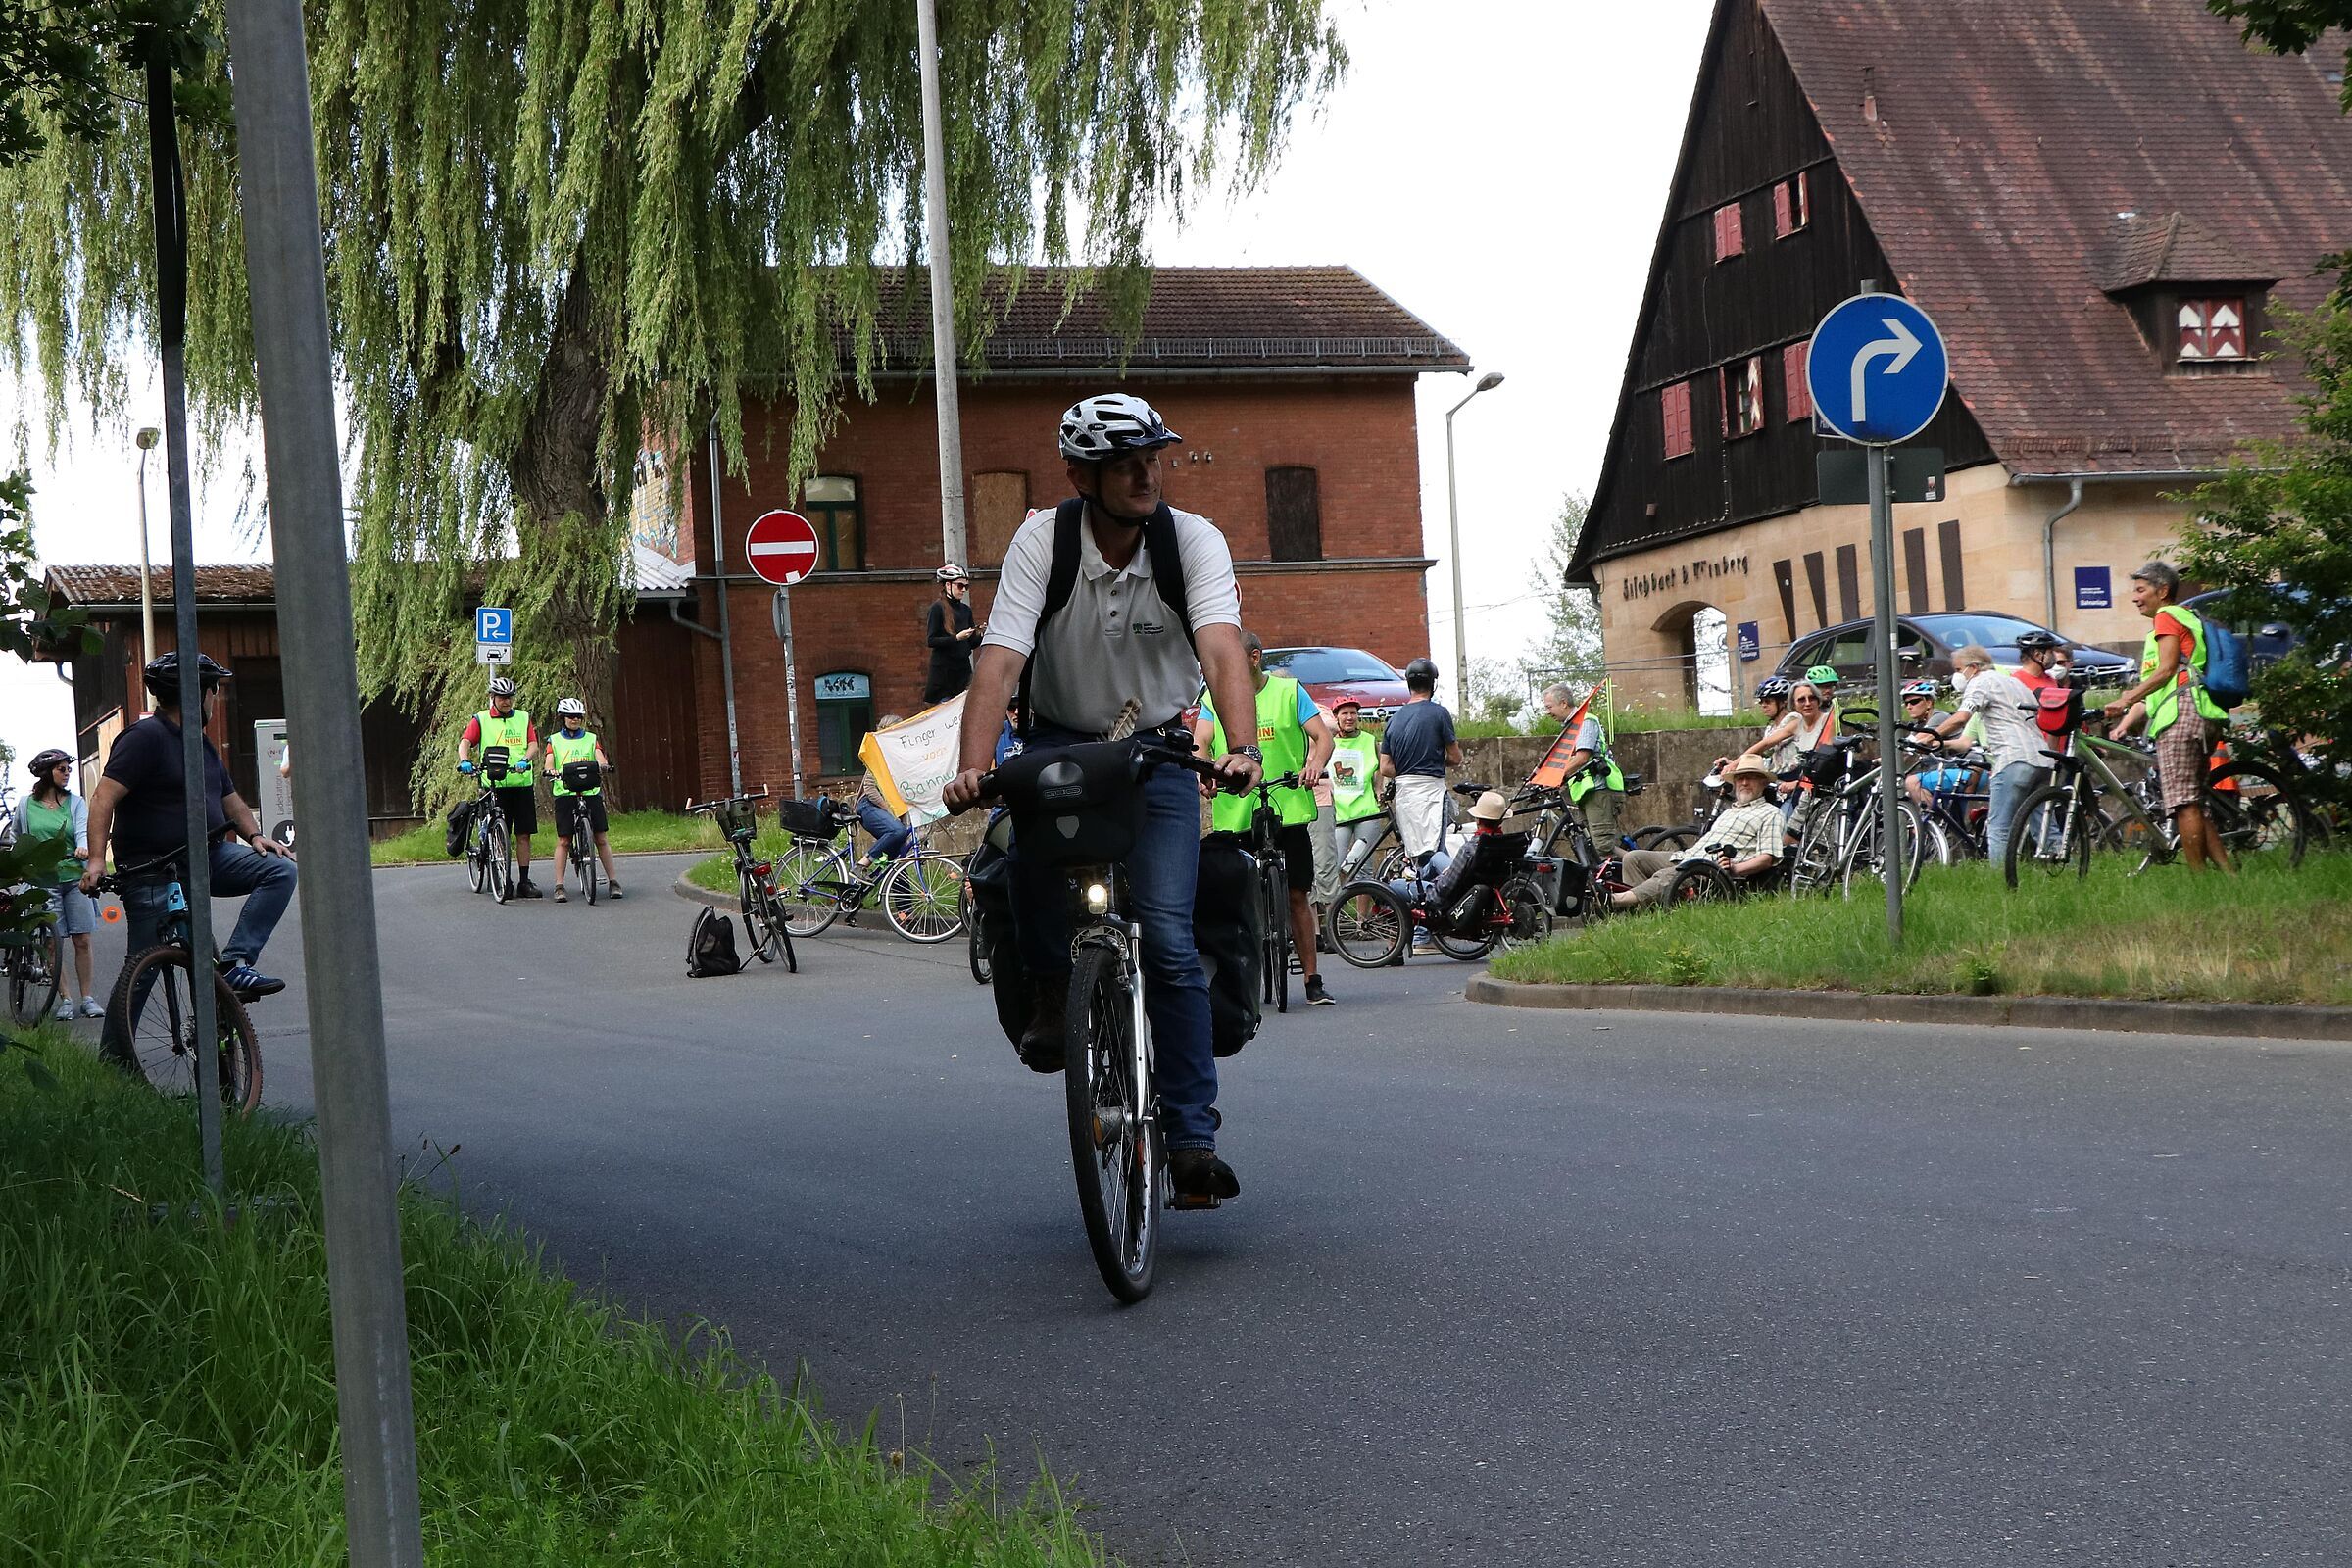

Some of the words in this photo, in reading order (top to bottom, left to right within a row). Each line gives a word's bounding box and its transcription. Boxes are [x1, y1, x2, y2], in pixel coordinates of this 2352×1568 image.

[482, 612, 502, 639] P
[900, 729, 936, 749] Finger
[899, 769, 955, 801] Bannw
